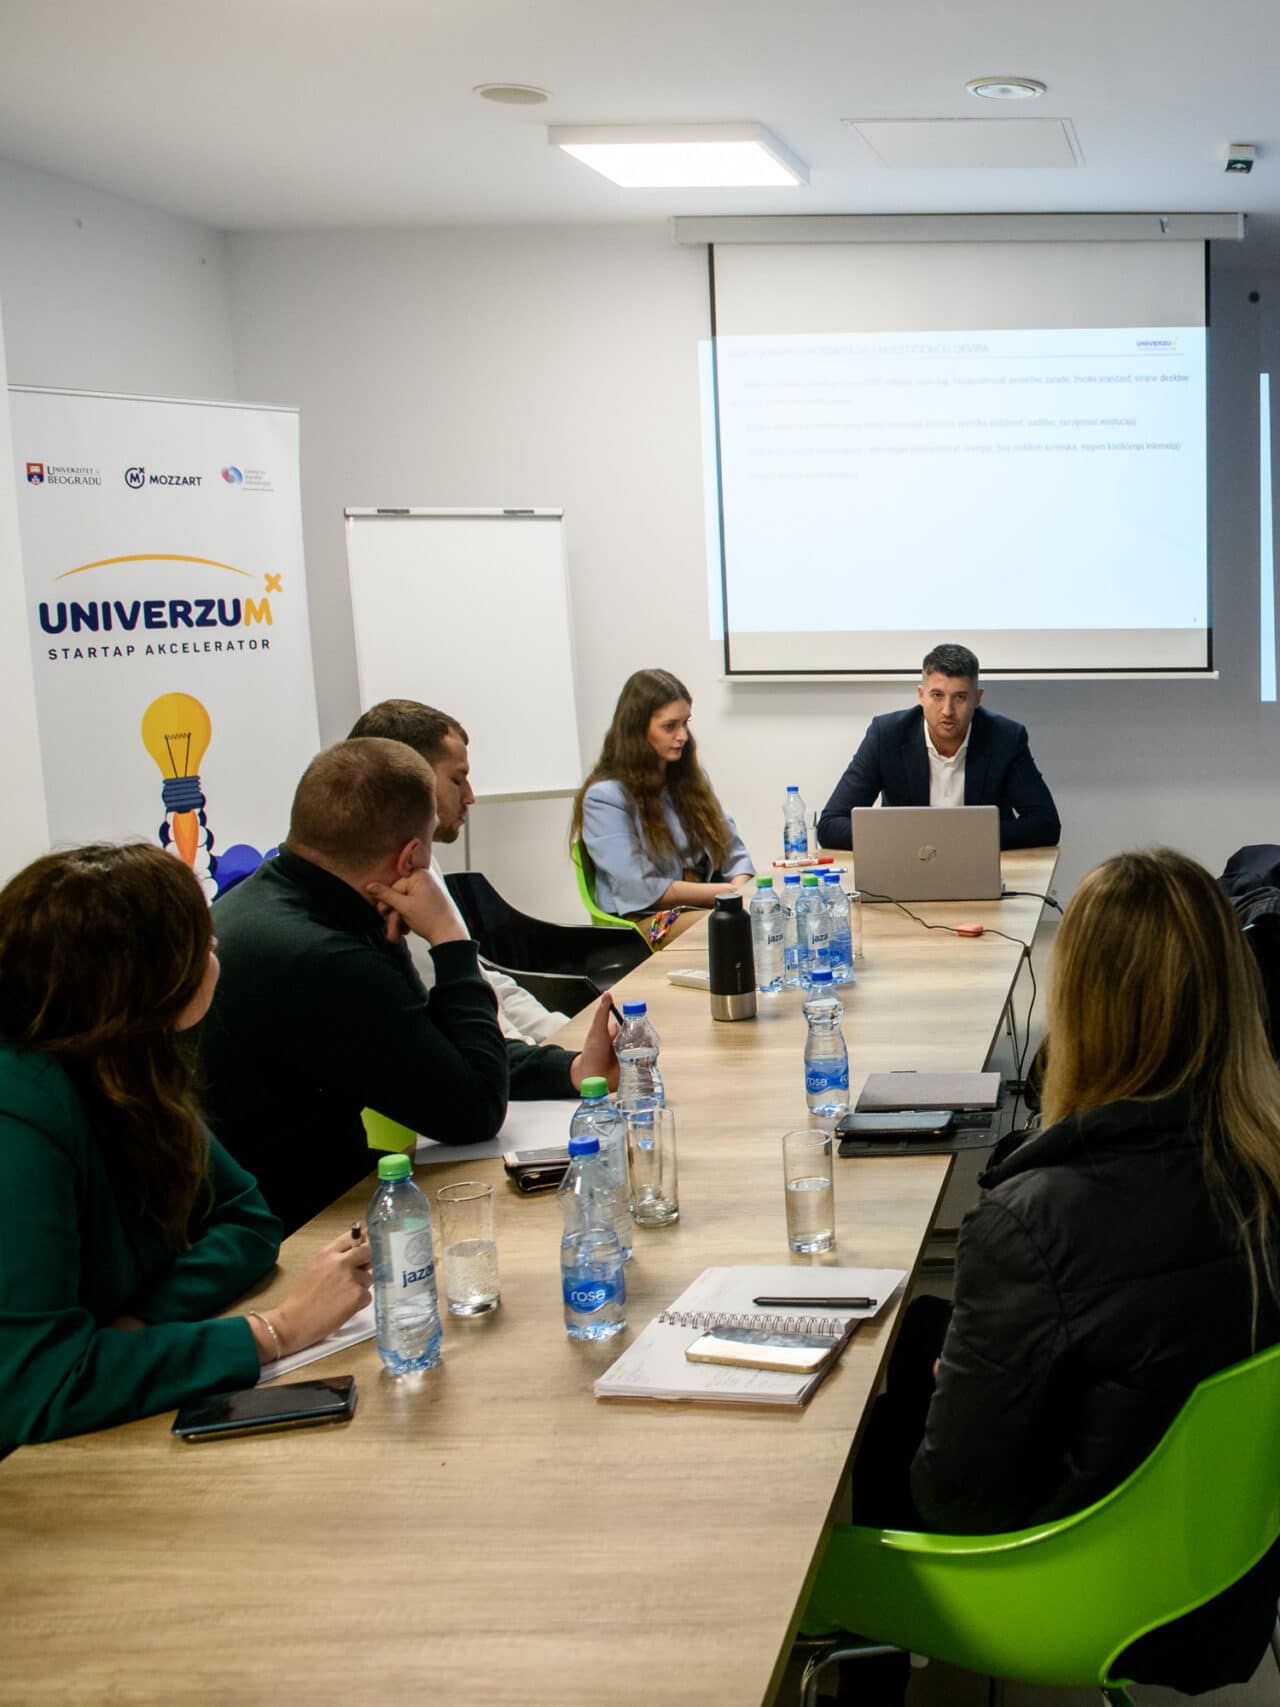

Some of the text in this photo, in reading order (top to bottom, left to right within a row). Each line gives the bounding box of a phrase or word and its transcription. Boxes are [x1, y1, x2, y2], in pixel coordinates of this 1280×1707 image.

[47, 475, 103, 486] BEOGRADU
[149, 475, 202, 486] MOZZART
[39, 597, 273, 634] UNIVERZUM
[47, 639, 271, 660] STARTAP AKCELERATOR
[571, 1289, 606, 1302] rosa
